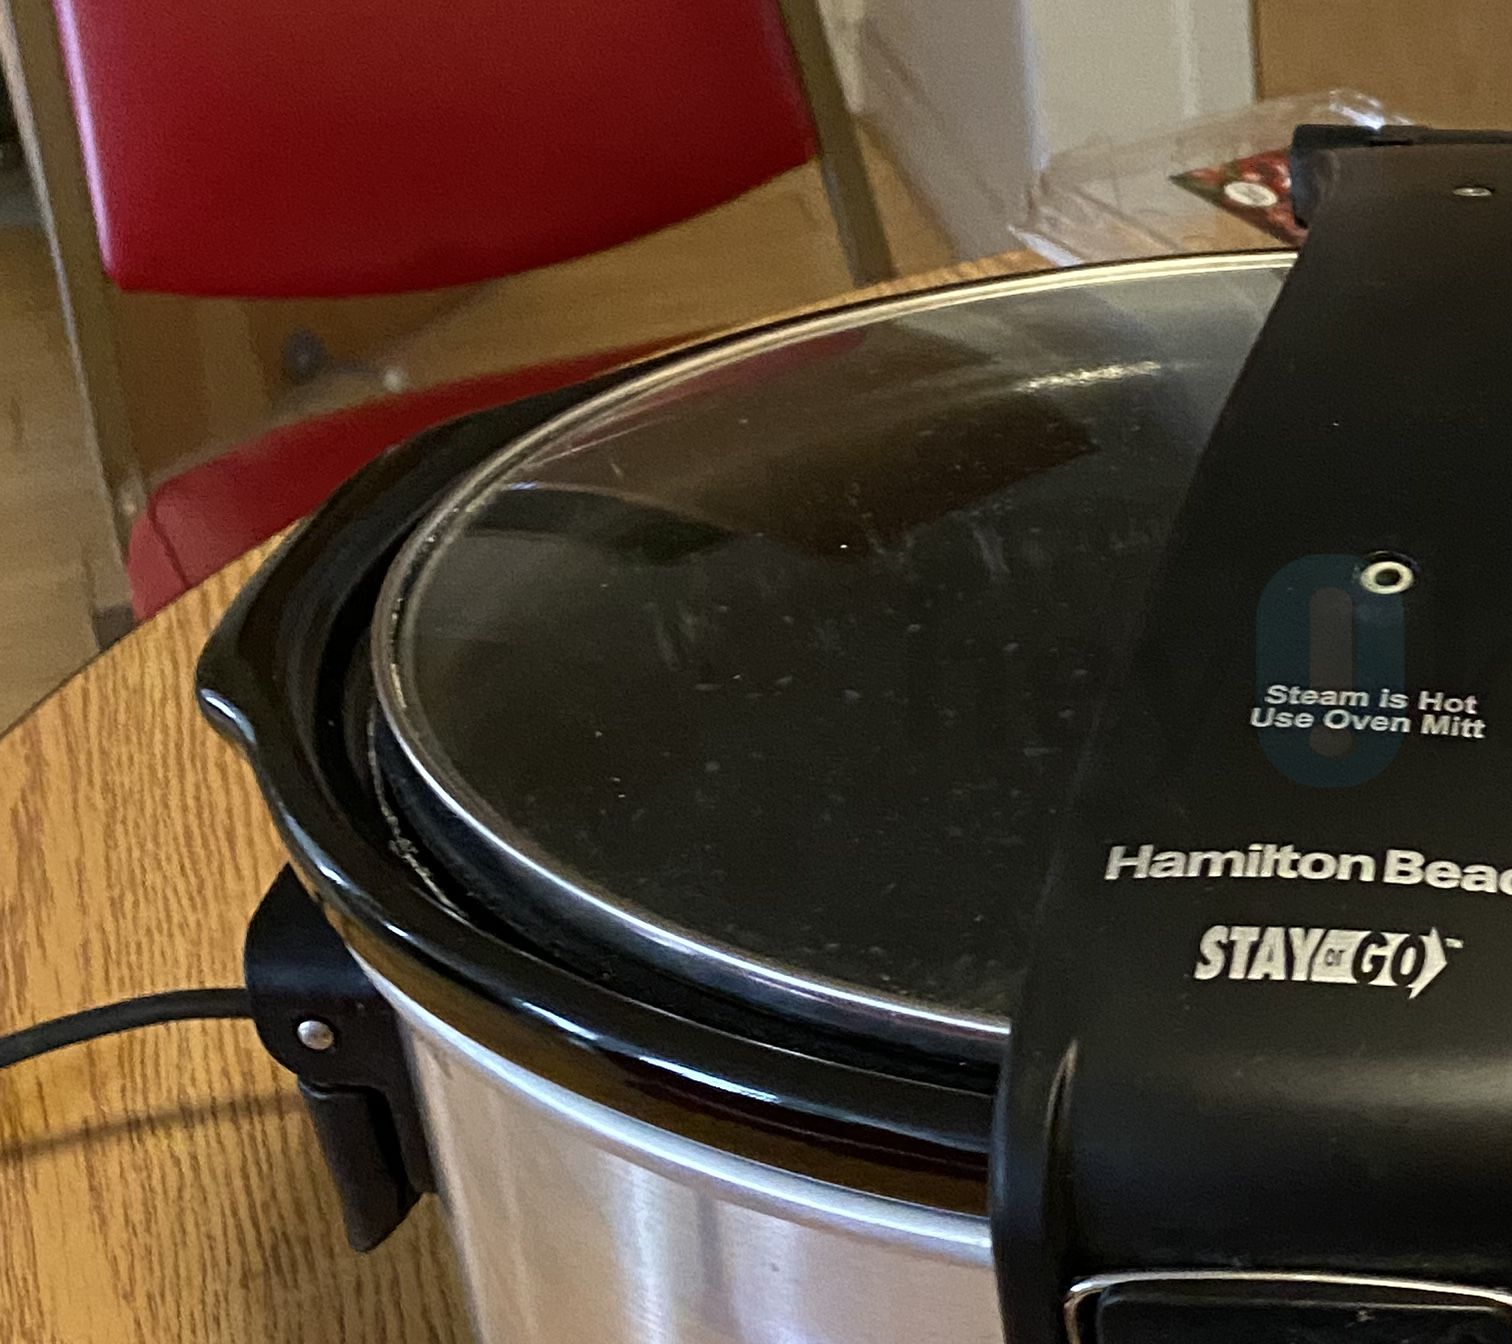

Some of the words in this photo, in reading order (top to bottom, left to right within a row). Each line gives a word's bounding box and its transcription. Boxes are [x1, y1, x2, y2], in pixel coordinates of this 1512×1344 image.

[1264, 684, 1370, 707] Steam
[1378, 688, 1409, 709] is
[1418, 690, 1478, 715] Hot
[1250, 707, 1315, 728] Use
[1322, 709, 1412, 733] Oven
[1420, 714, 1487, 739] Mitt
[1104, 843, 1376, 883] Hamilton
